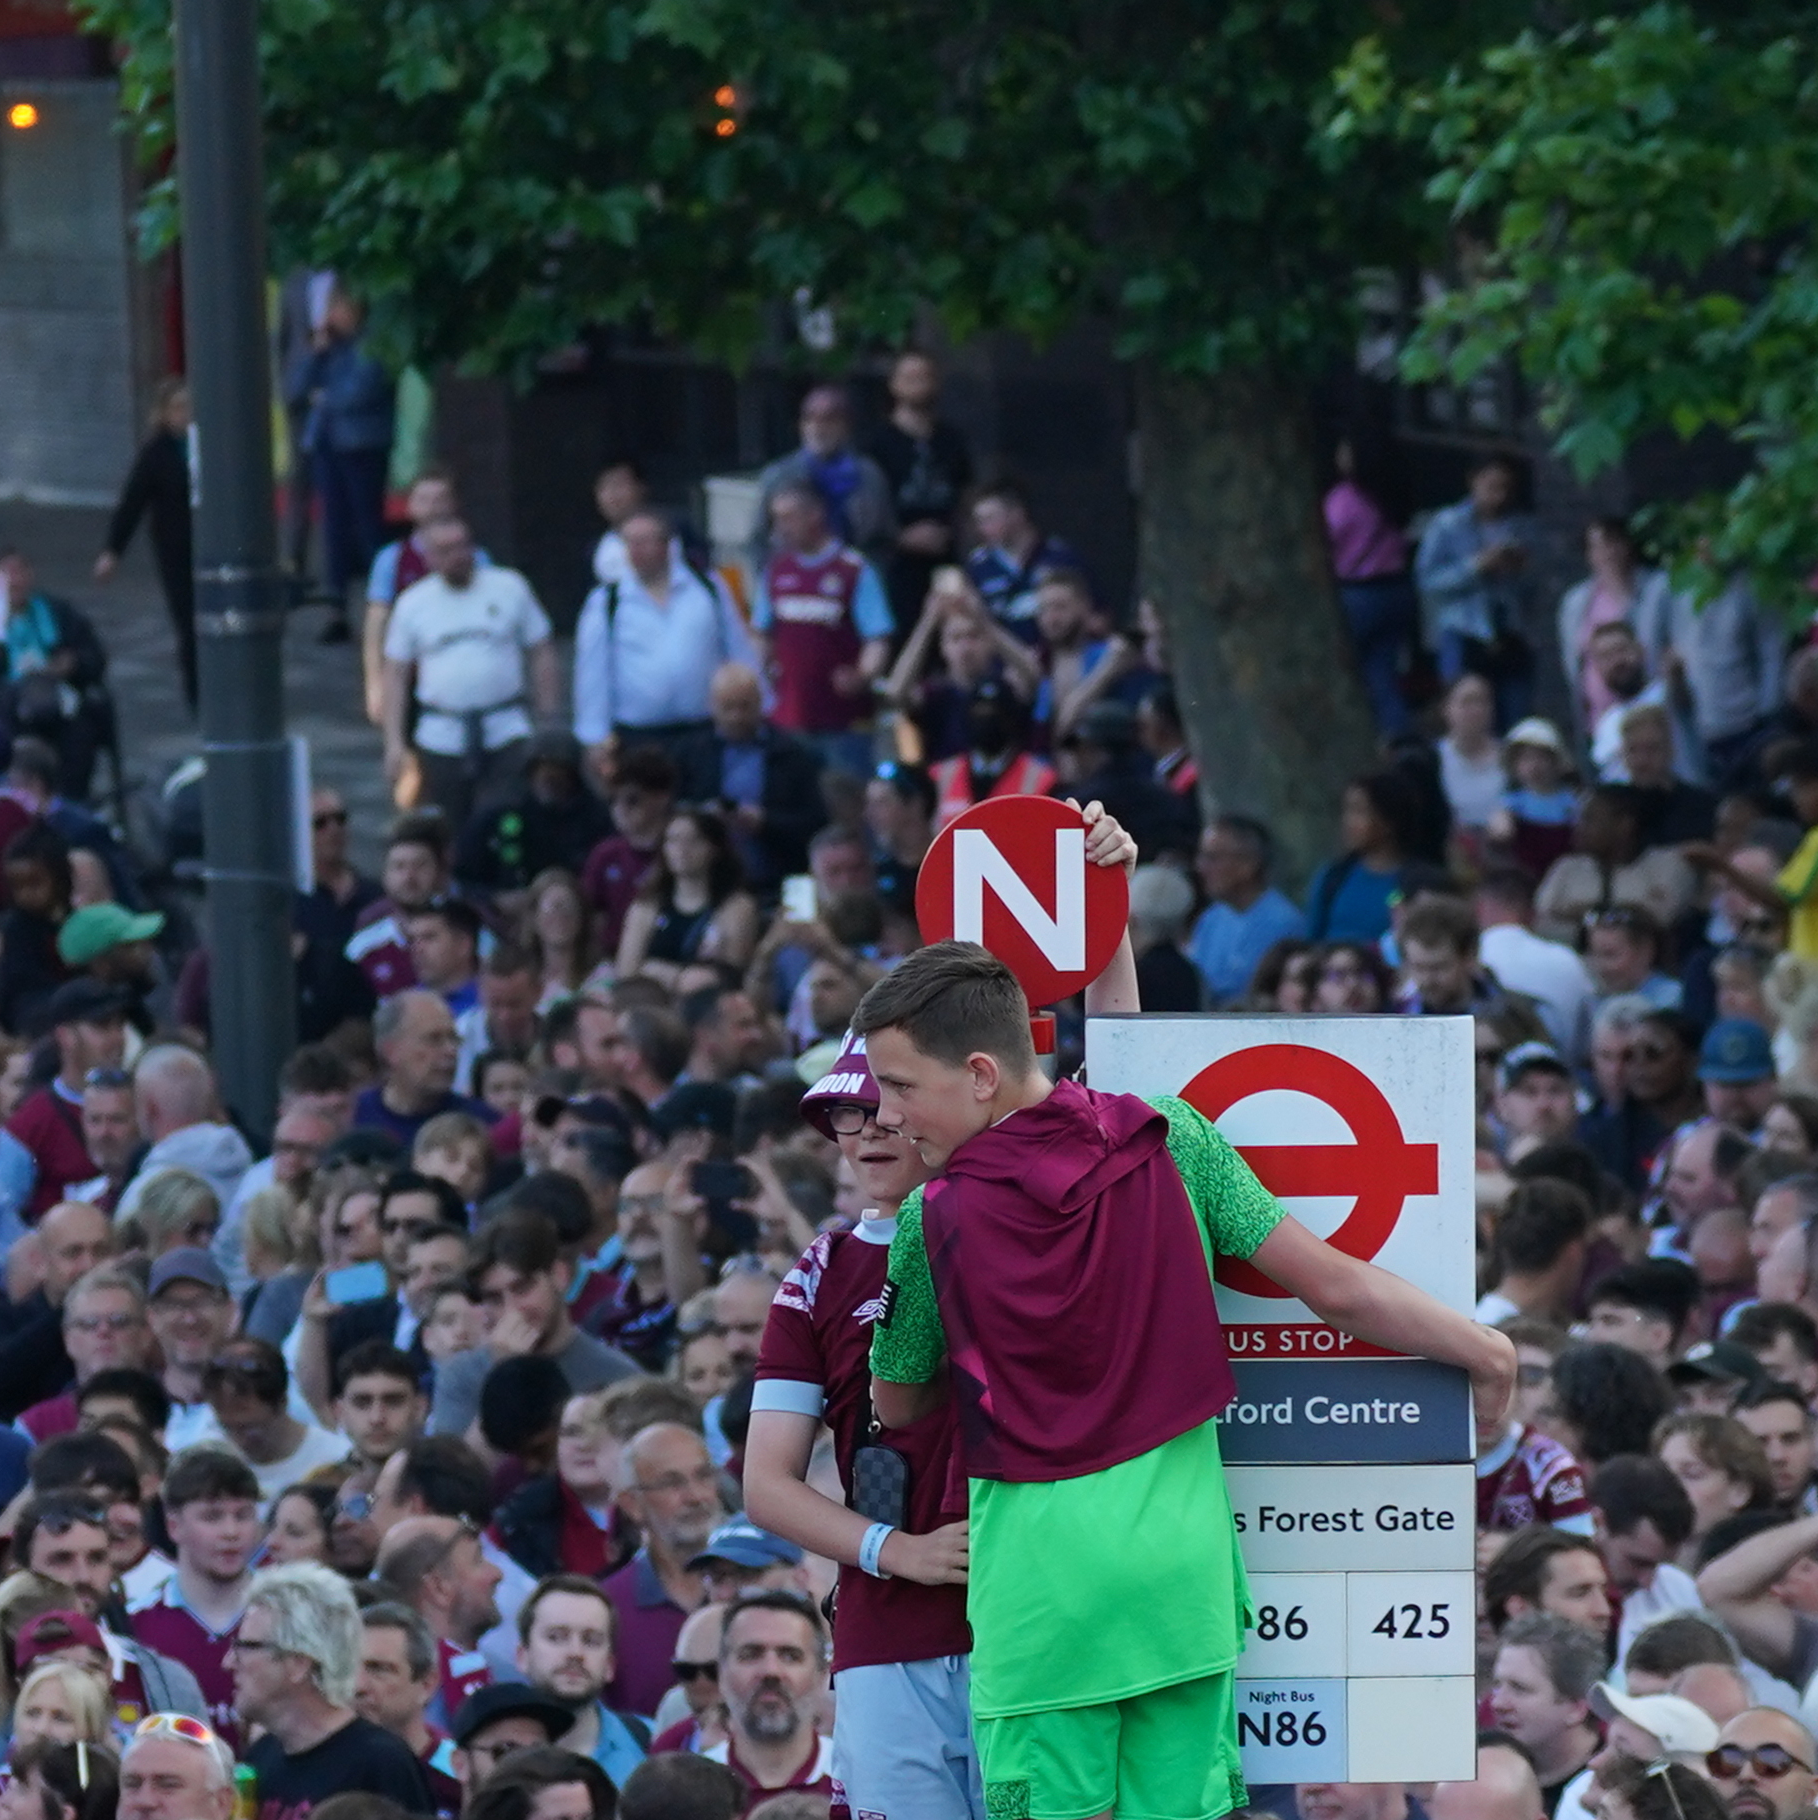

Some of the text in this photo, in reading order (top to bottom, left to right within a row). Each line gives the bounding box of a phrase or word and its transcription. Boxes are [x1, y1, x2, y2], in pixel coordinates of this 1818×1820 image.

[953, 828, 1087, 972] N
[1223, 1330, 1354, 1352] US STOP
[1305, 1396, 1420, 1424] Centre
[1259, 1507, 1364, 1532] Forest
[1376, 1505, 1454, 1530] Gate
[1257, 1605, 1308, 1641] 86
[1372, 1604, 1450, 1638] 425
[1249, 1690, 1315, 1705] Night Bus
[1238, 1711, 1327, 1746] N86
